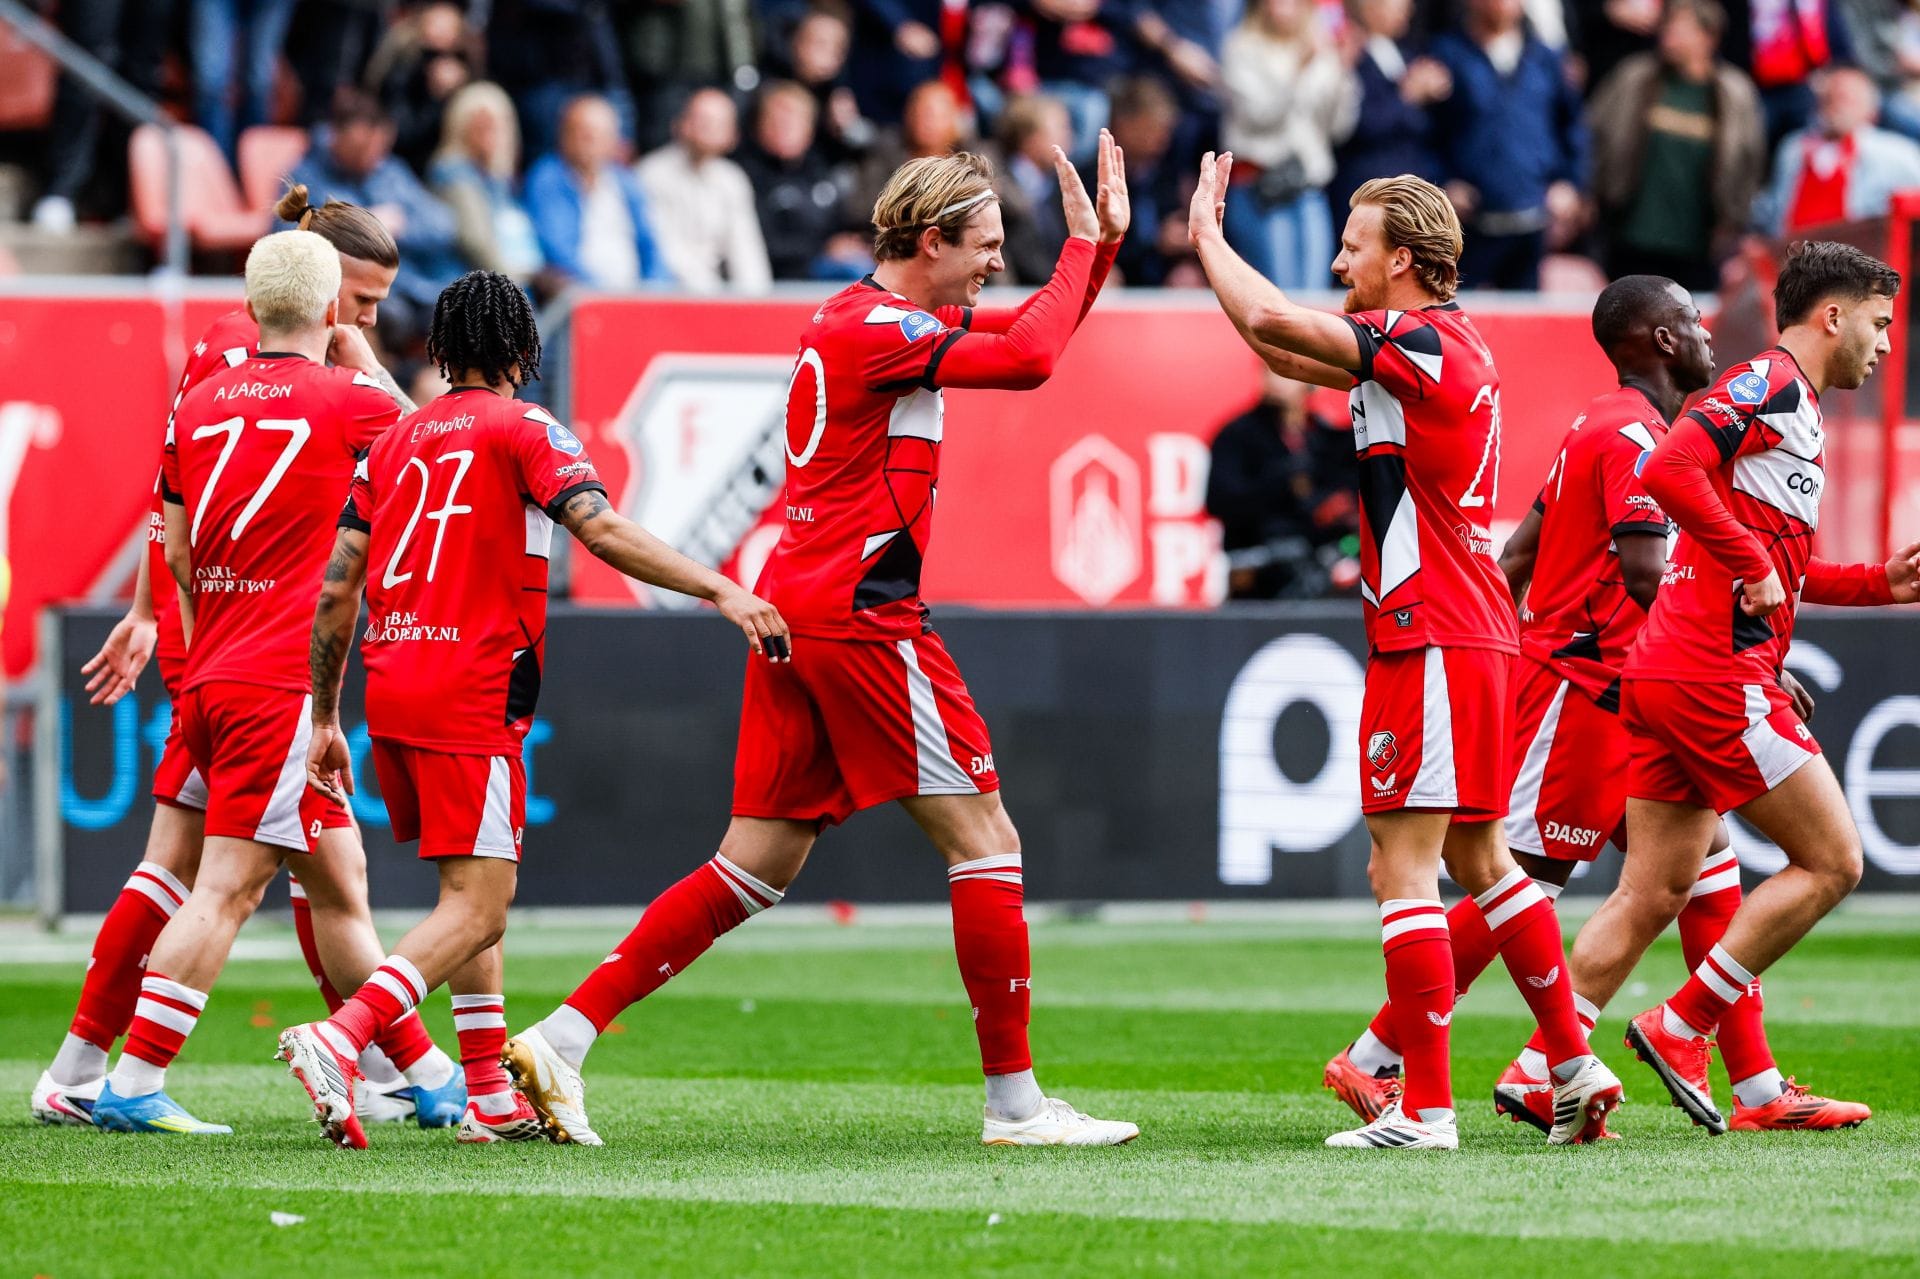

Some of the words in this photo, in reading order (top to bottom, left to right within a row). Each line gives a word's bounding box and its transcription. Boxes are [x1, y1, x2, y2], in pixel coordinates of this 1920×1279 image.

[191, 416, 312, 548] 77
[382, 449, 474, 590] 27
[1543, 820, 1602, 847] DASSY
